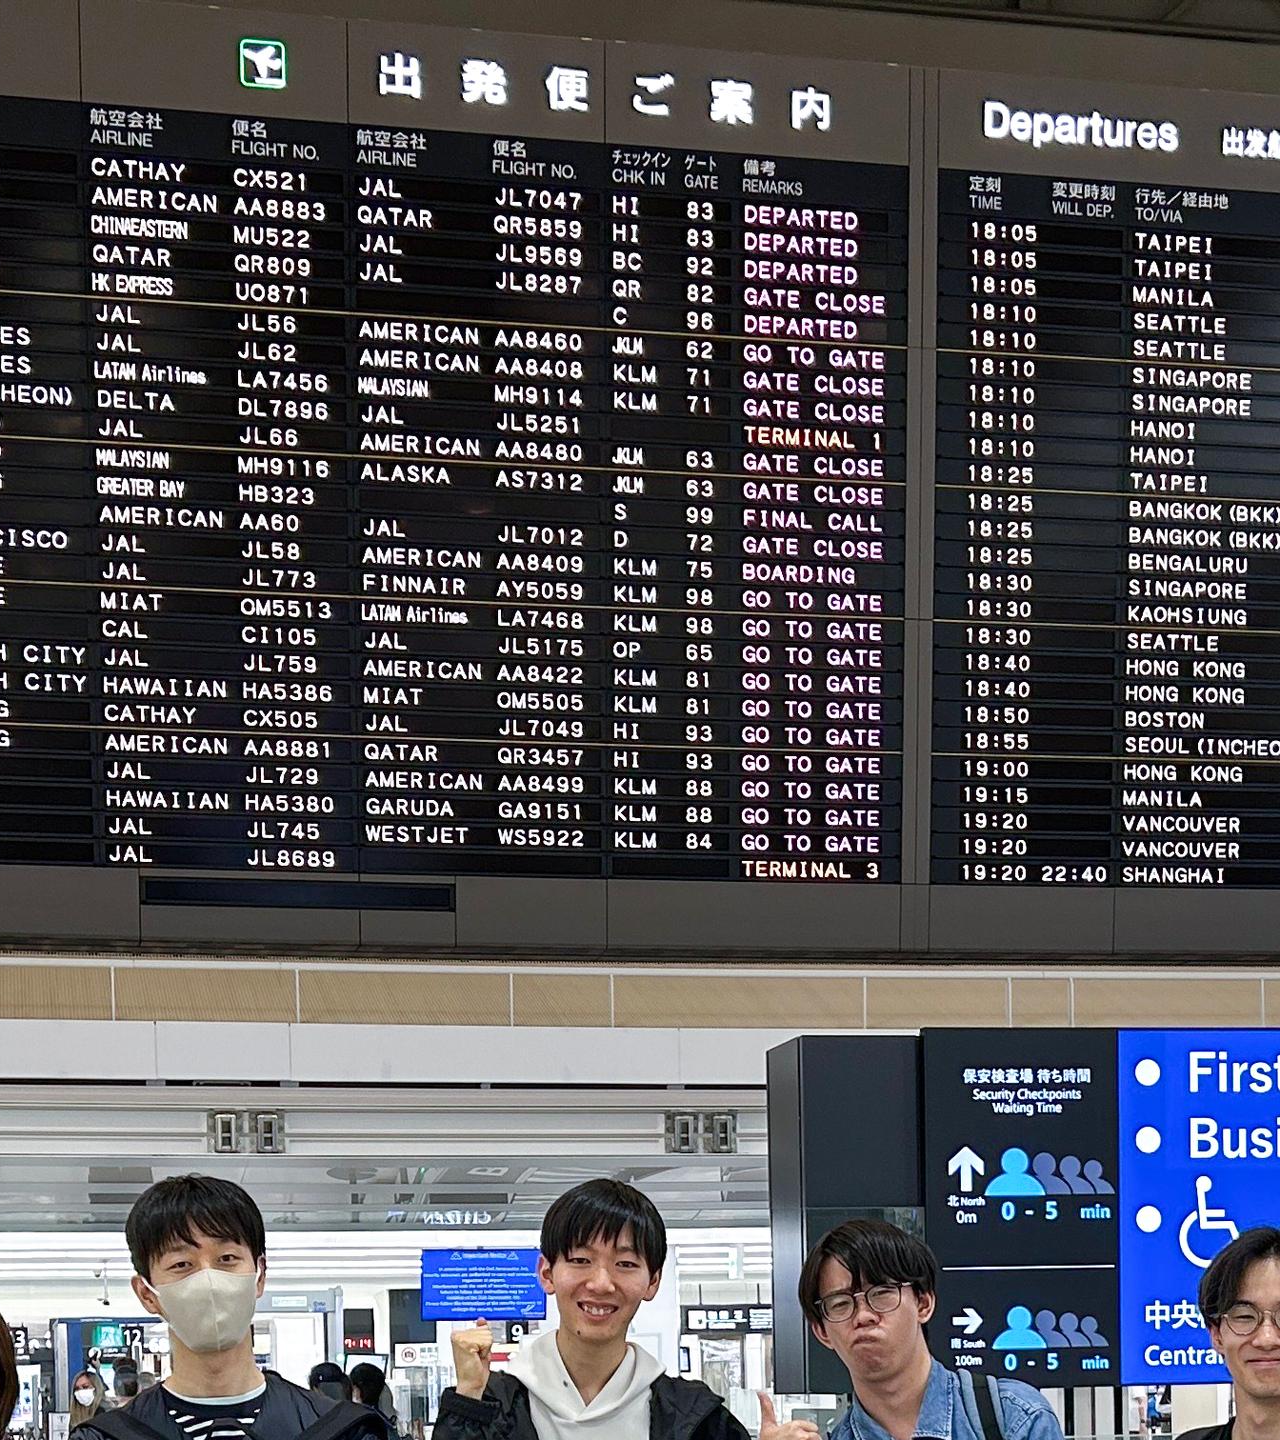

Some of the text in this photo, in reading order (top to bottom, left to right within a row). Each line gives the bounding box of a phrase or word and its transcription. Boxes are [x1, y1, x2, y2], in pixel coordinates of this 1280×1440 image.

[379, 52, 831, 131] 出発便ご案内
[90, 108, 163, 131] 航空会社
[984, 101, 1179, 153] Departures
[90, 129, 154, 149] AIRLINE
[612, 168, 646, 186] CHK
[651, 170, 666, 186] IN
[684, 174, 719, 190] GATE
[742, 178, 803, 197] REMARKS
[91, 157, 186, 182] CATHAY
[233, 167, 306, 192] CX521
[358, 176, 402, 198] JAL
[495, 187, 582, 211] JL7047
[612, 195, 639, 216] HI
[686, 200, 714, 221] 83
[744, 204, 858, 231] DEPARTED
[97, 389, 176, 412] DELTA
[238, 397, 329, 421] DL7896
[361, 405, 404, 425] JAL
[496, 412, 579, 434] JL5251
[743, 425, 856, 449] TERMINAL
[873, 432, 880, 450] 1
[966, 627, 1031, 646] 18:30
[1127, 632, 1219, 652] SEATTLE
[963, 812, 1028, 830] 19:20
[1122, 815, 1241, 833] VANCOUVER
[108, 817, 153, 835] JAL
[247, 821, 320, 840] JL745
[365, 824, 469, 844] WESTJET
[497, 828, 584, 847] WS5922
[614, 831, 657, 849] KLM
[685, 832, 713, 850] 84
[741, 833, 770, 851] GO
[783, 834, 812, 852] TO
[824, 835, 880, 853] GATE
[972, 1088, 1082, 1102] Security Checkpoints
[992, 1102, 1063, 1116] Waiting Time
[956, 1211, 977, 1224] 0m
[1001, 1201, 1015, 1221] 0
[1045, 1201, 1058, 1220] 5
[1080, 1204, 1111, 1219] min
[955, 1355, 982, 1366] 100m
[1004, 1353, 1017, 1371] 0
[1047, 1353, 1059, 1370] 5
[1082, 1355, 1109, 1369] min
